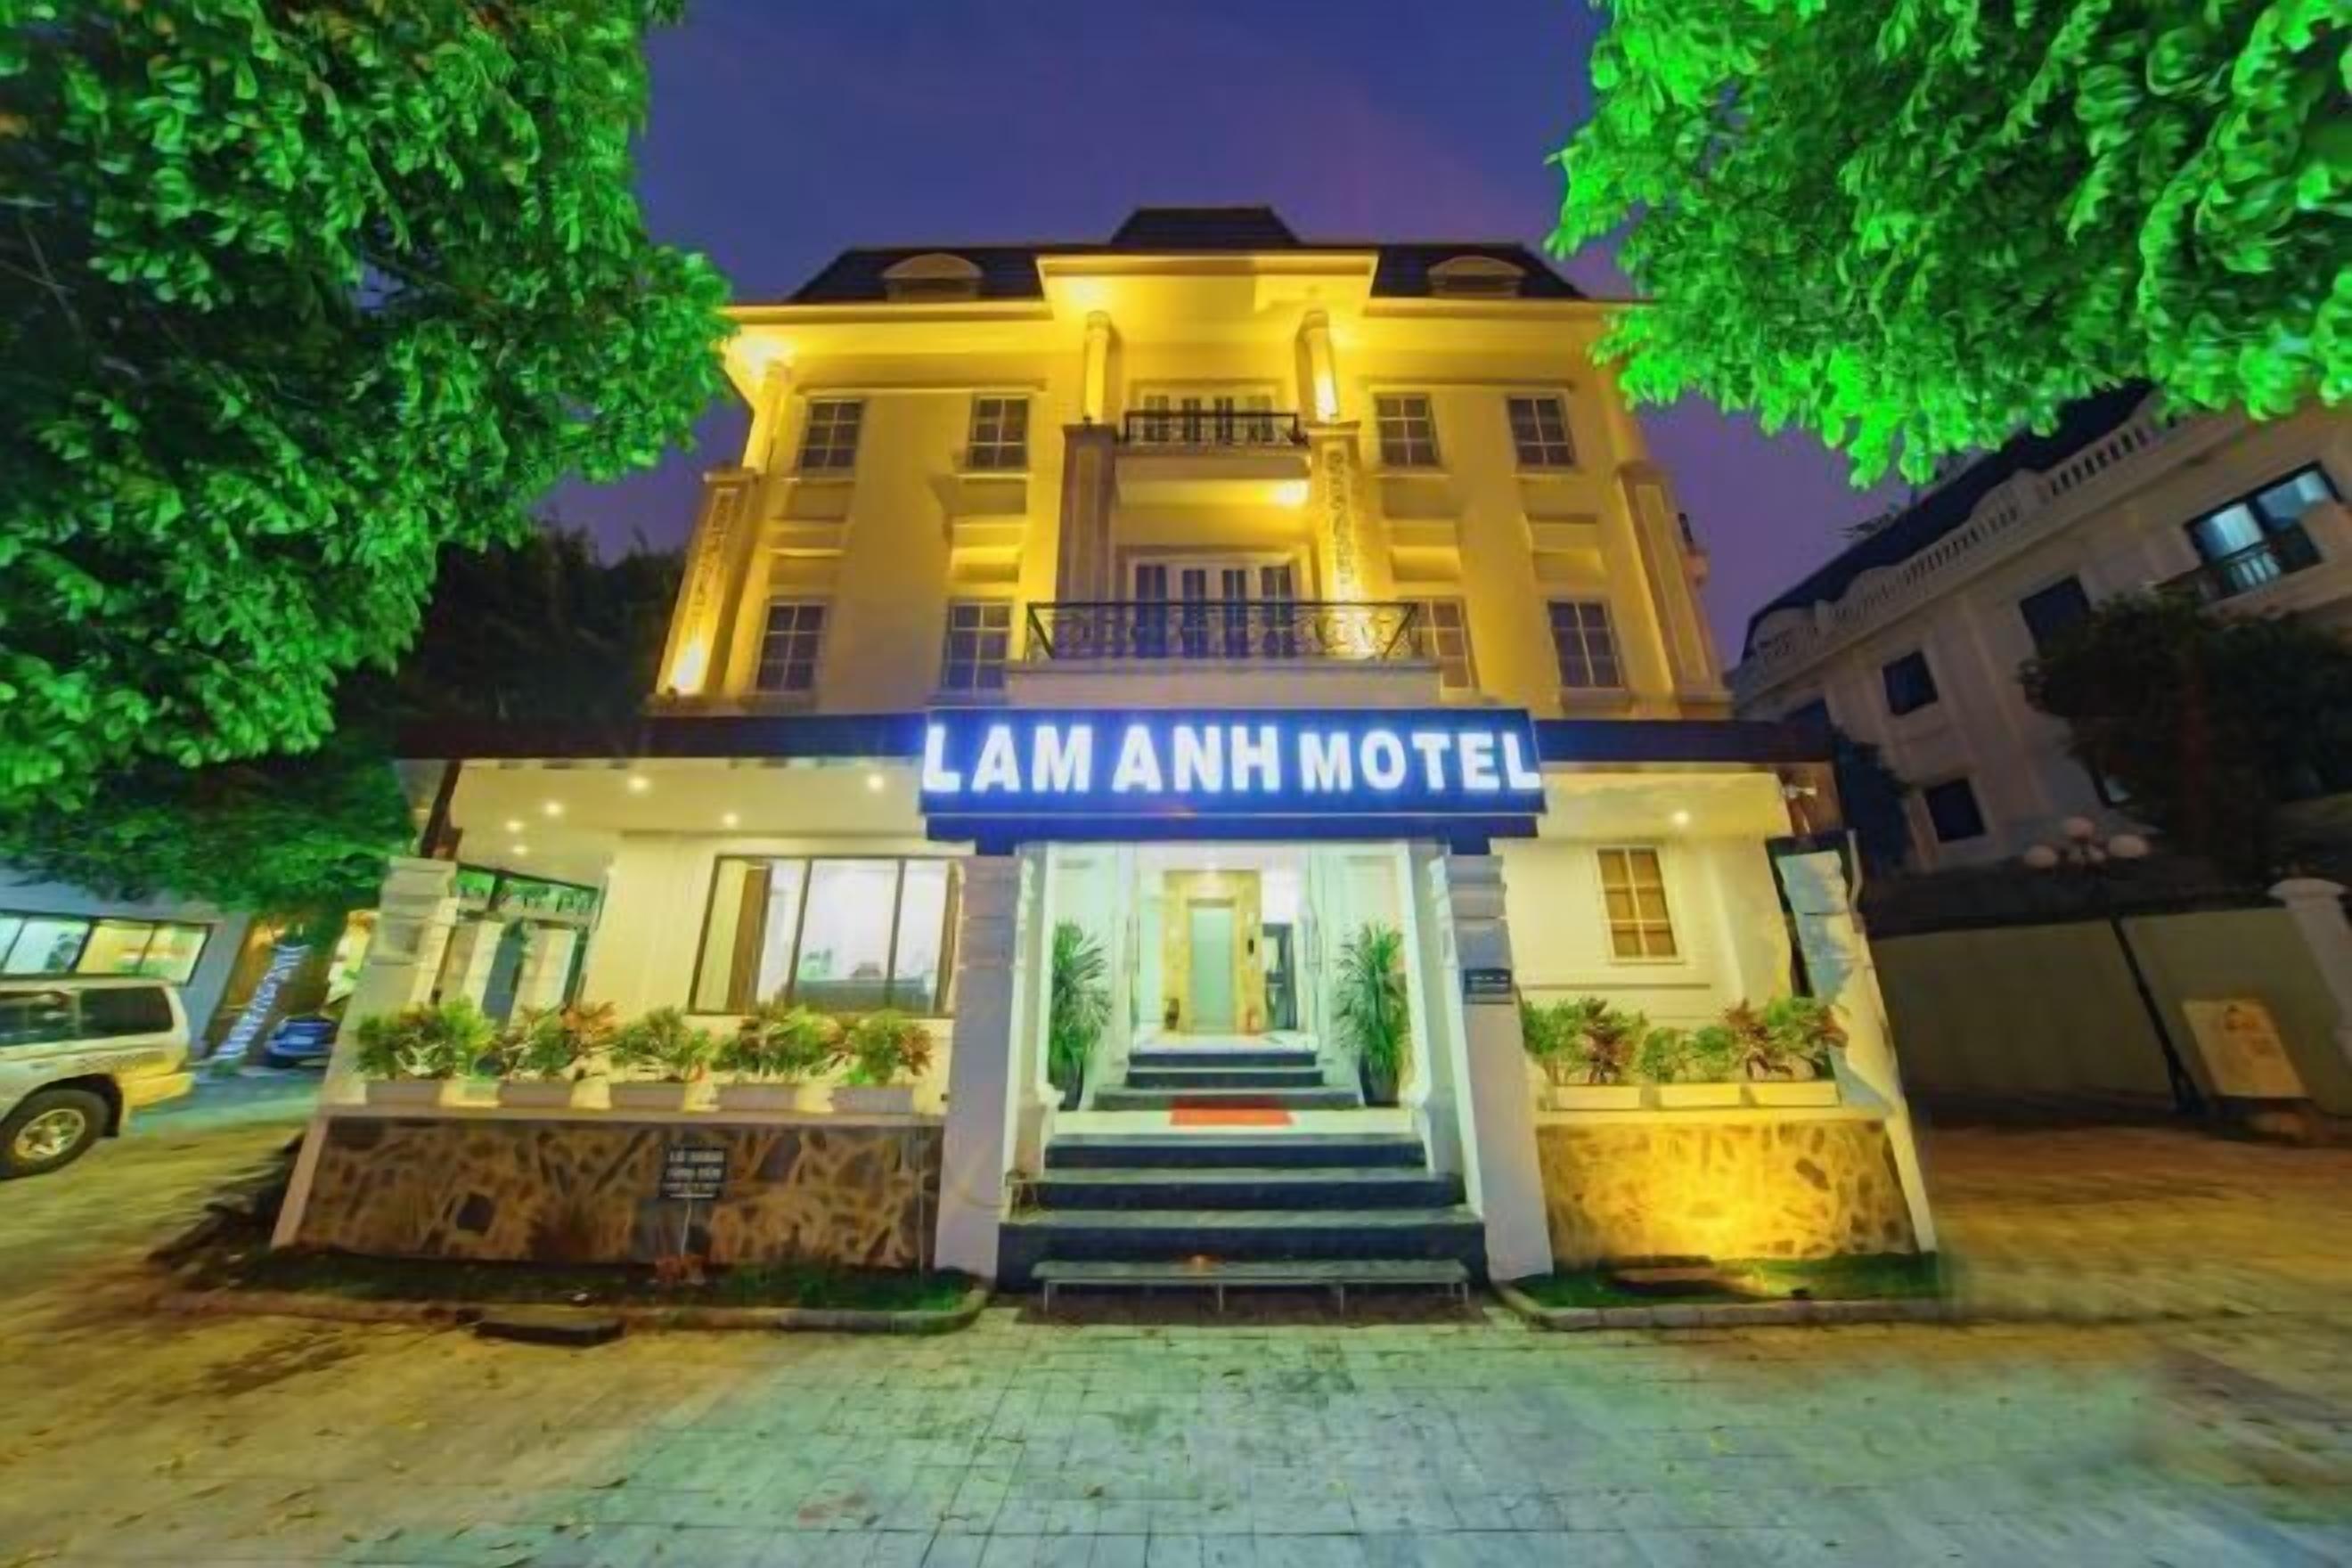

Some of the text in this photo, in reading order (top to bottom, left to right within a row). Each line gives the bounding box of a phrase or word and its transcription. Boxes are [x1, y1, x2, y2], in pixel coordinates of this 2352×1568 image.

[922, 725, 1541, 792] LAM ANH MOTEL
